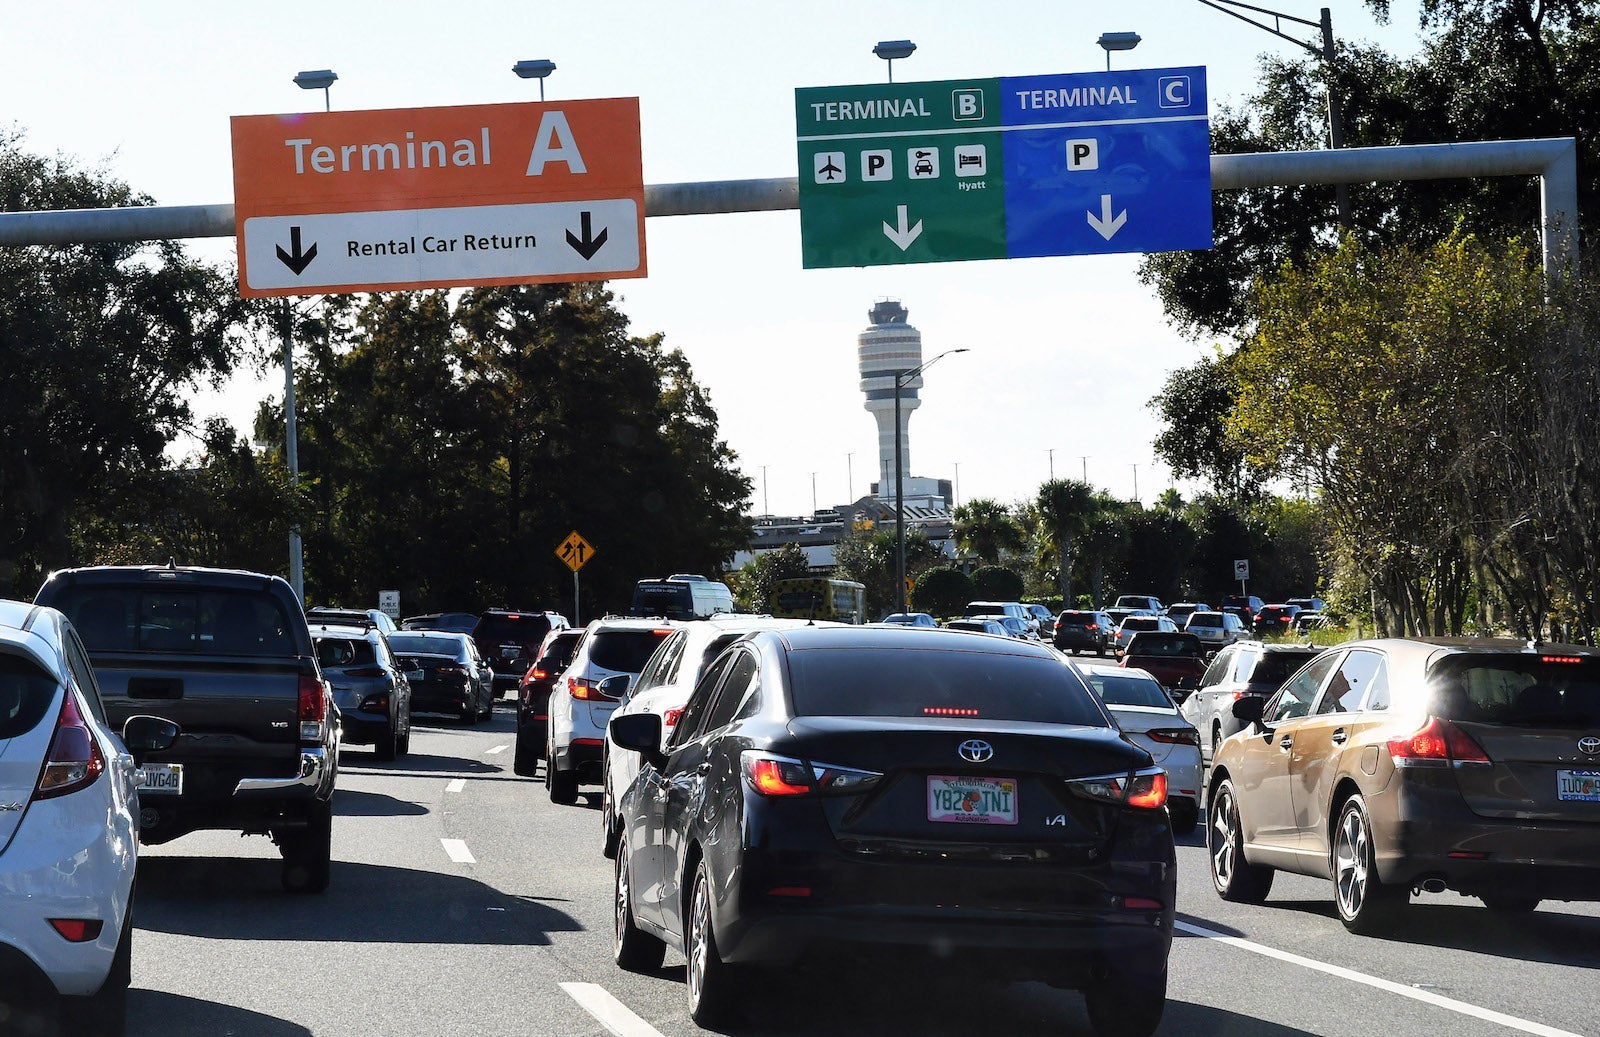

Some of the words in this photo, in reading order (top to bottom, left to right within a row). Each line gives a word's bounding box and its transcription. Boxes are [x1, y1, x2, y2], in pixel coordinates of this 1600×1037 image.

[1016, 85, 1137, 110] TERMINAL
[1163, 80, 1184, 103] C
[811, 97, 931, 122] TERMINAL
[958, 94, 977, 116] B
[285, 127, 492, 175] Terminal
[525, 110, 588, 177] A
[1073, 144, 1091, 166] P
[868, 155, 885, 177] P
[958, 180, 986, 191] Hyatt
[347, 236, 416, 258] Rental
[422, 235, 458, 254] Car
[463, 231, 537, 252] Return
[1045, 814, 1067, 826] iA
